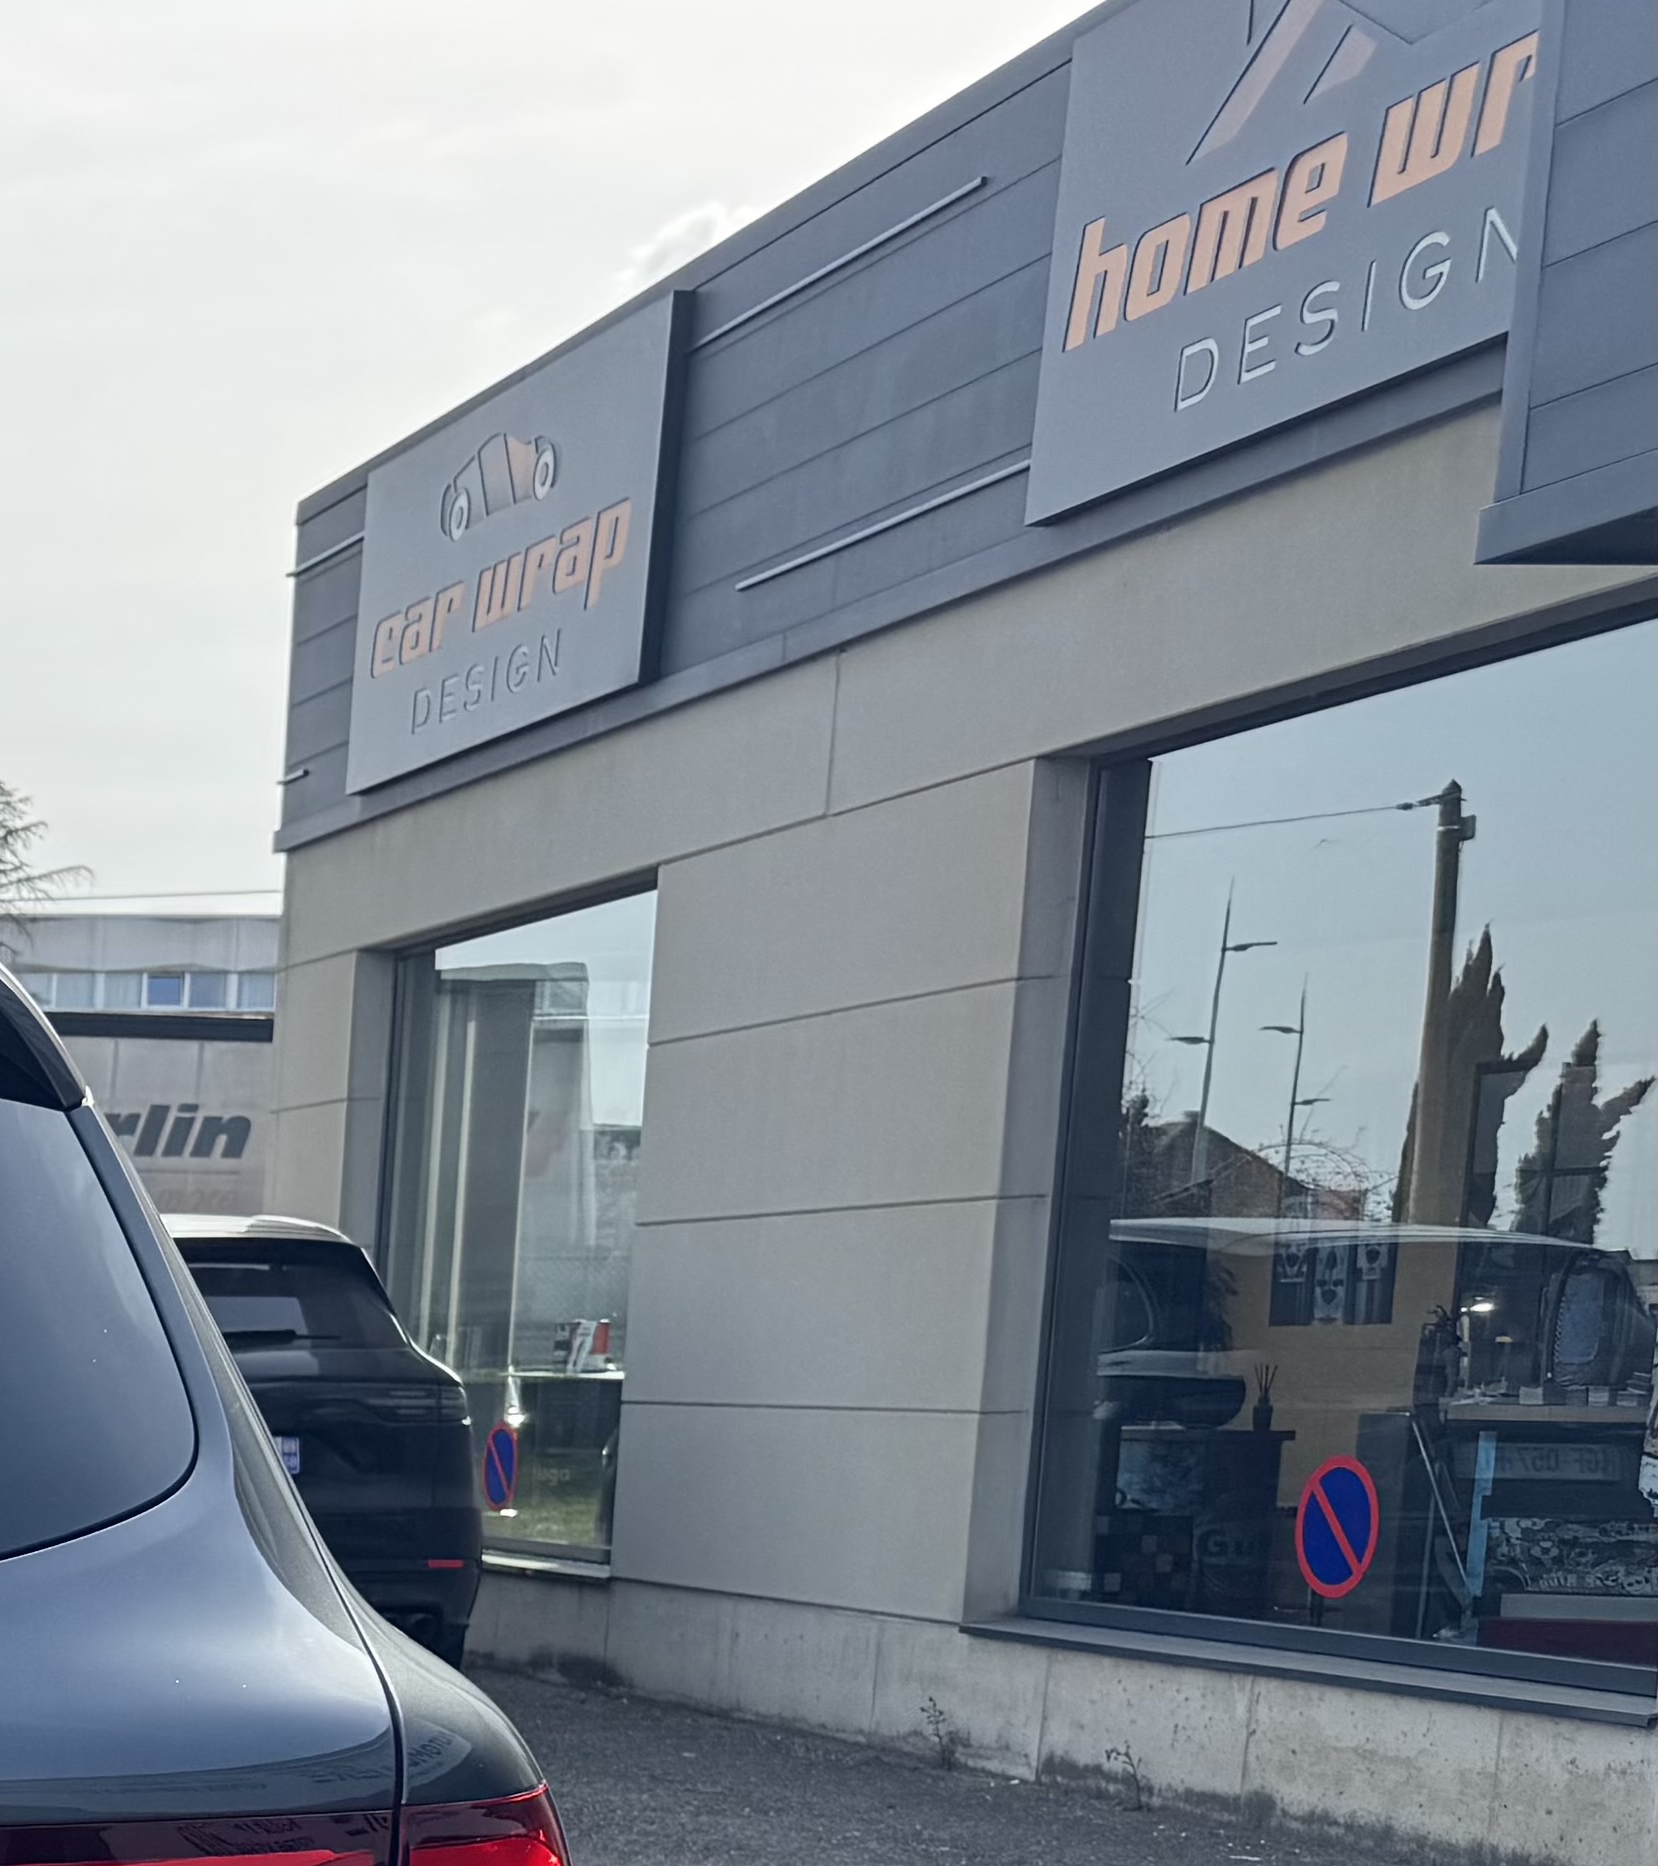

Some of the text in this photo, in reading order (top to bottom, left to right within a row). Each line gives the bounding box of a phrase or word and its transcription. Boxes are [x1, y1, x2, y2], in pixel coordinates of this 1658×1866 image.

[1062, 131, 1348, 353] home
[371, 497, 631, 679] car wrap
[411, 629, 562, 735] DESIGN
